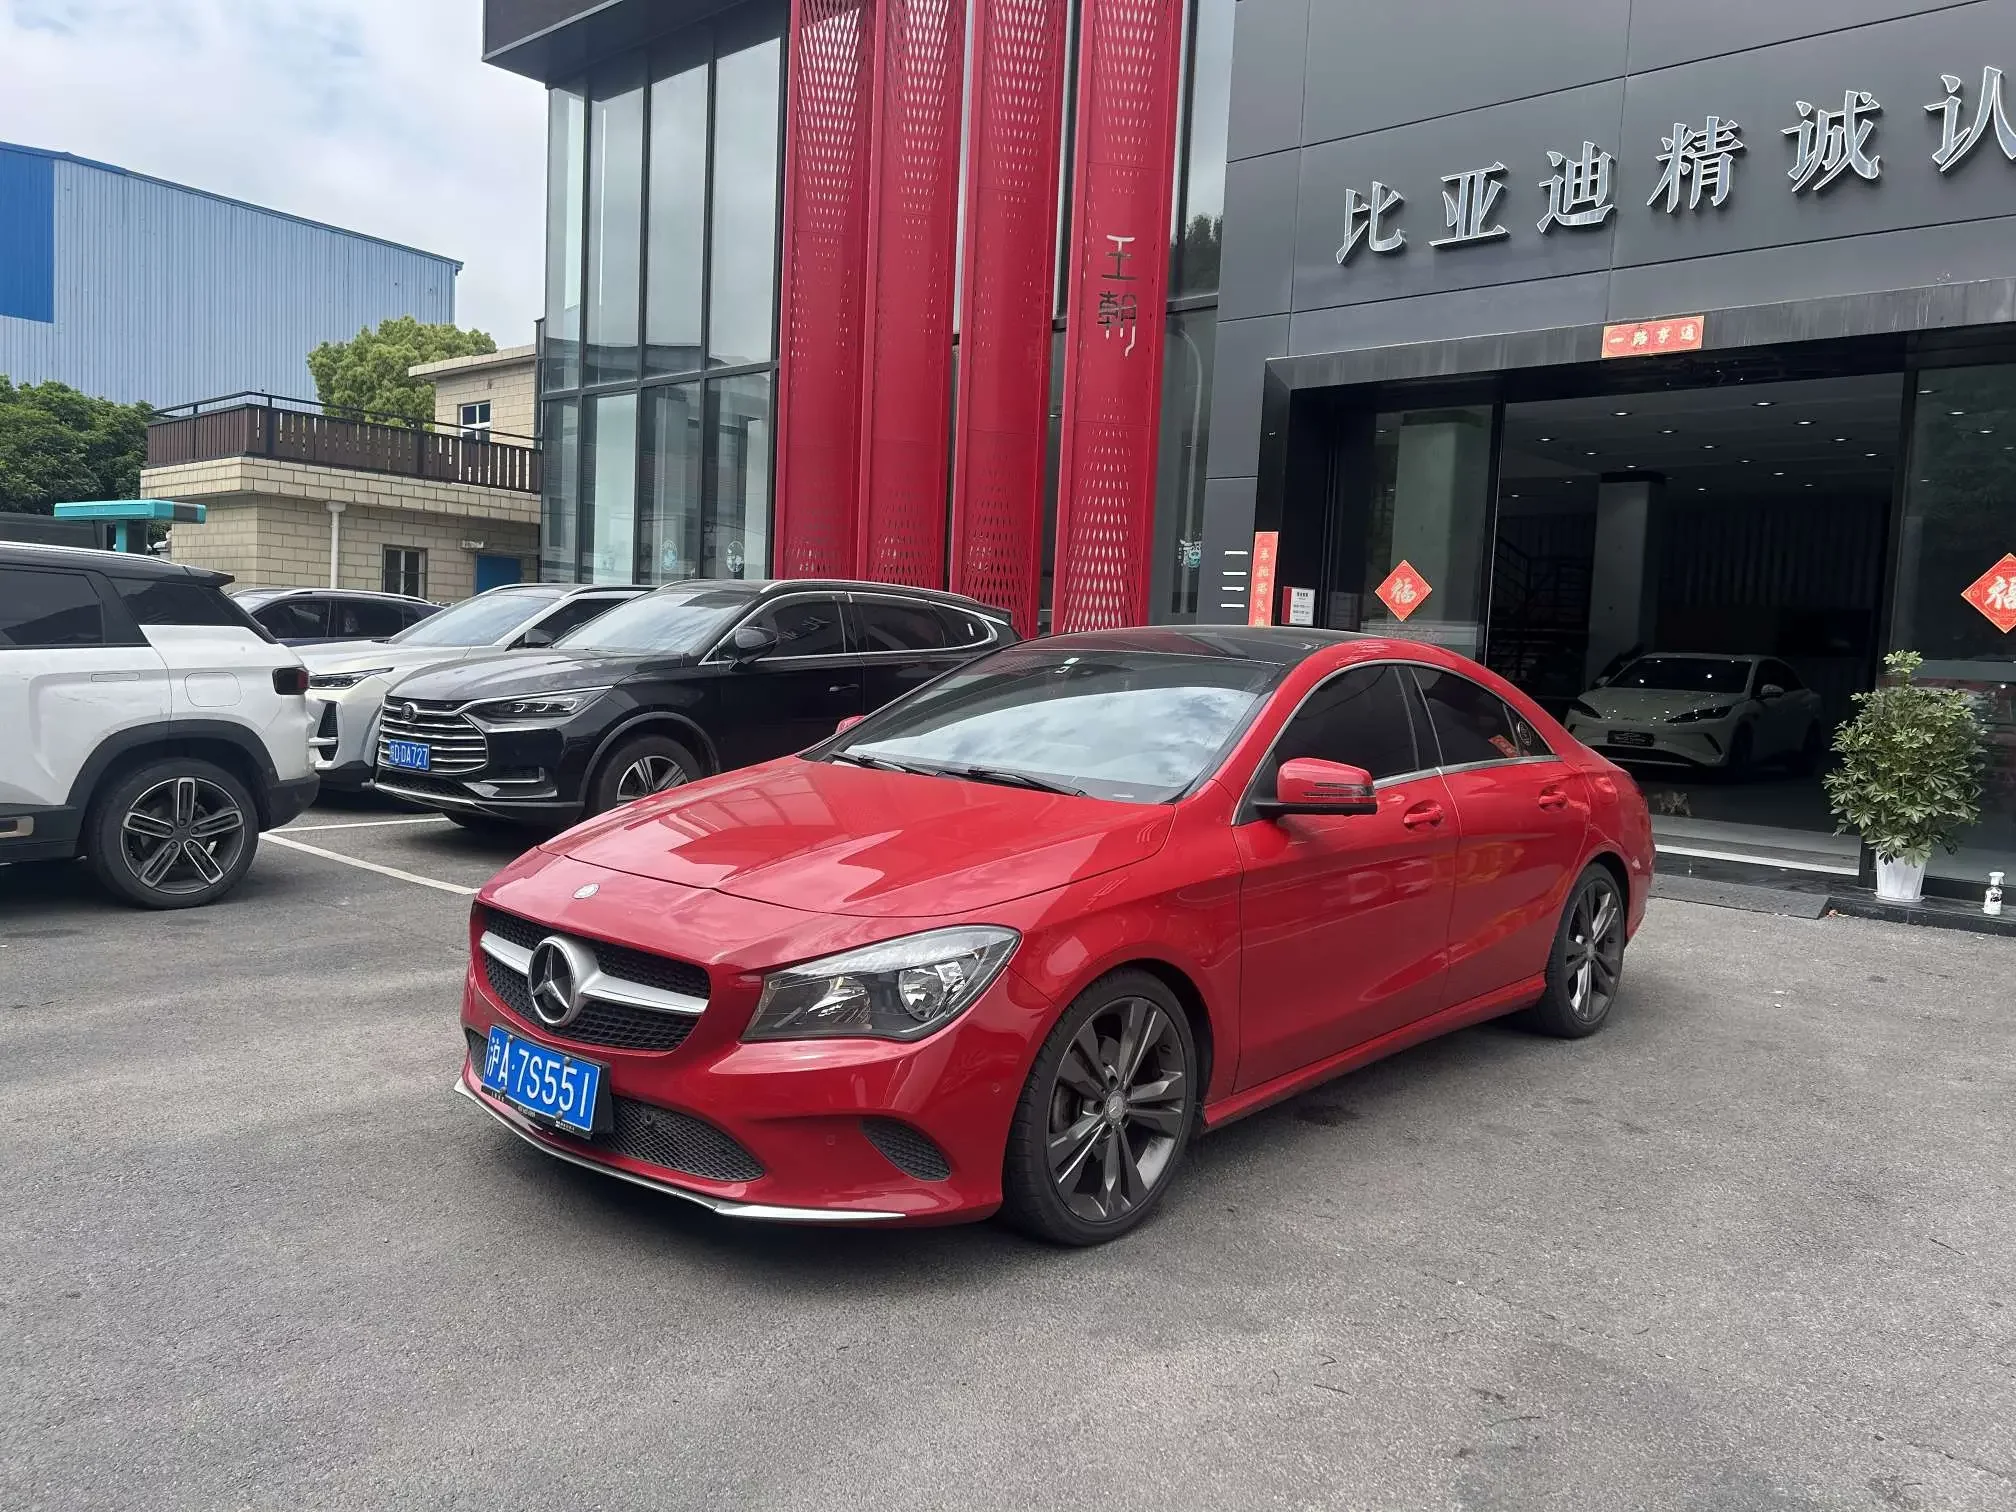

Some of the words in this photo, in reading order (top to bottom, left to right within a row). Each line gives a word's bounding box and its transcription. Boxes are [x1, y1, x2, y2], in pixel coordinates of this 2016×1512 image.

[1336, 65, 2016, 264] 比亚迪精诚认
[1390, 577, 1417, 605] 福
